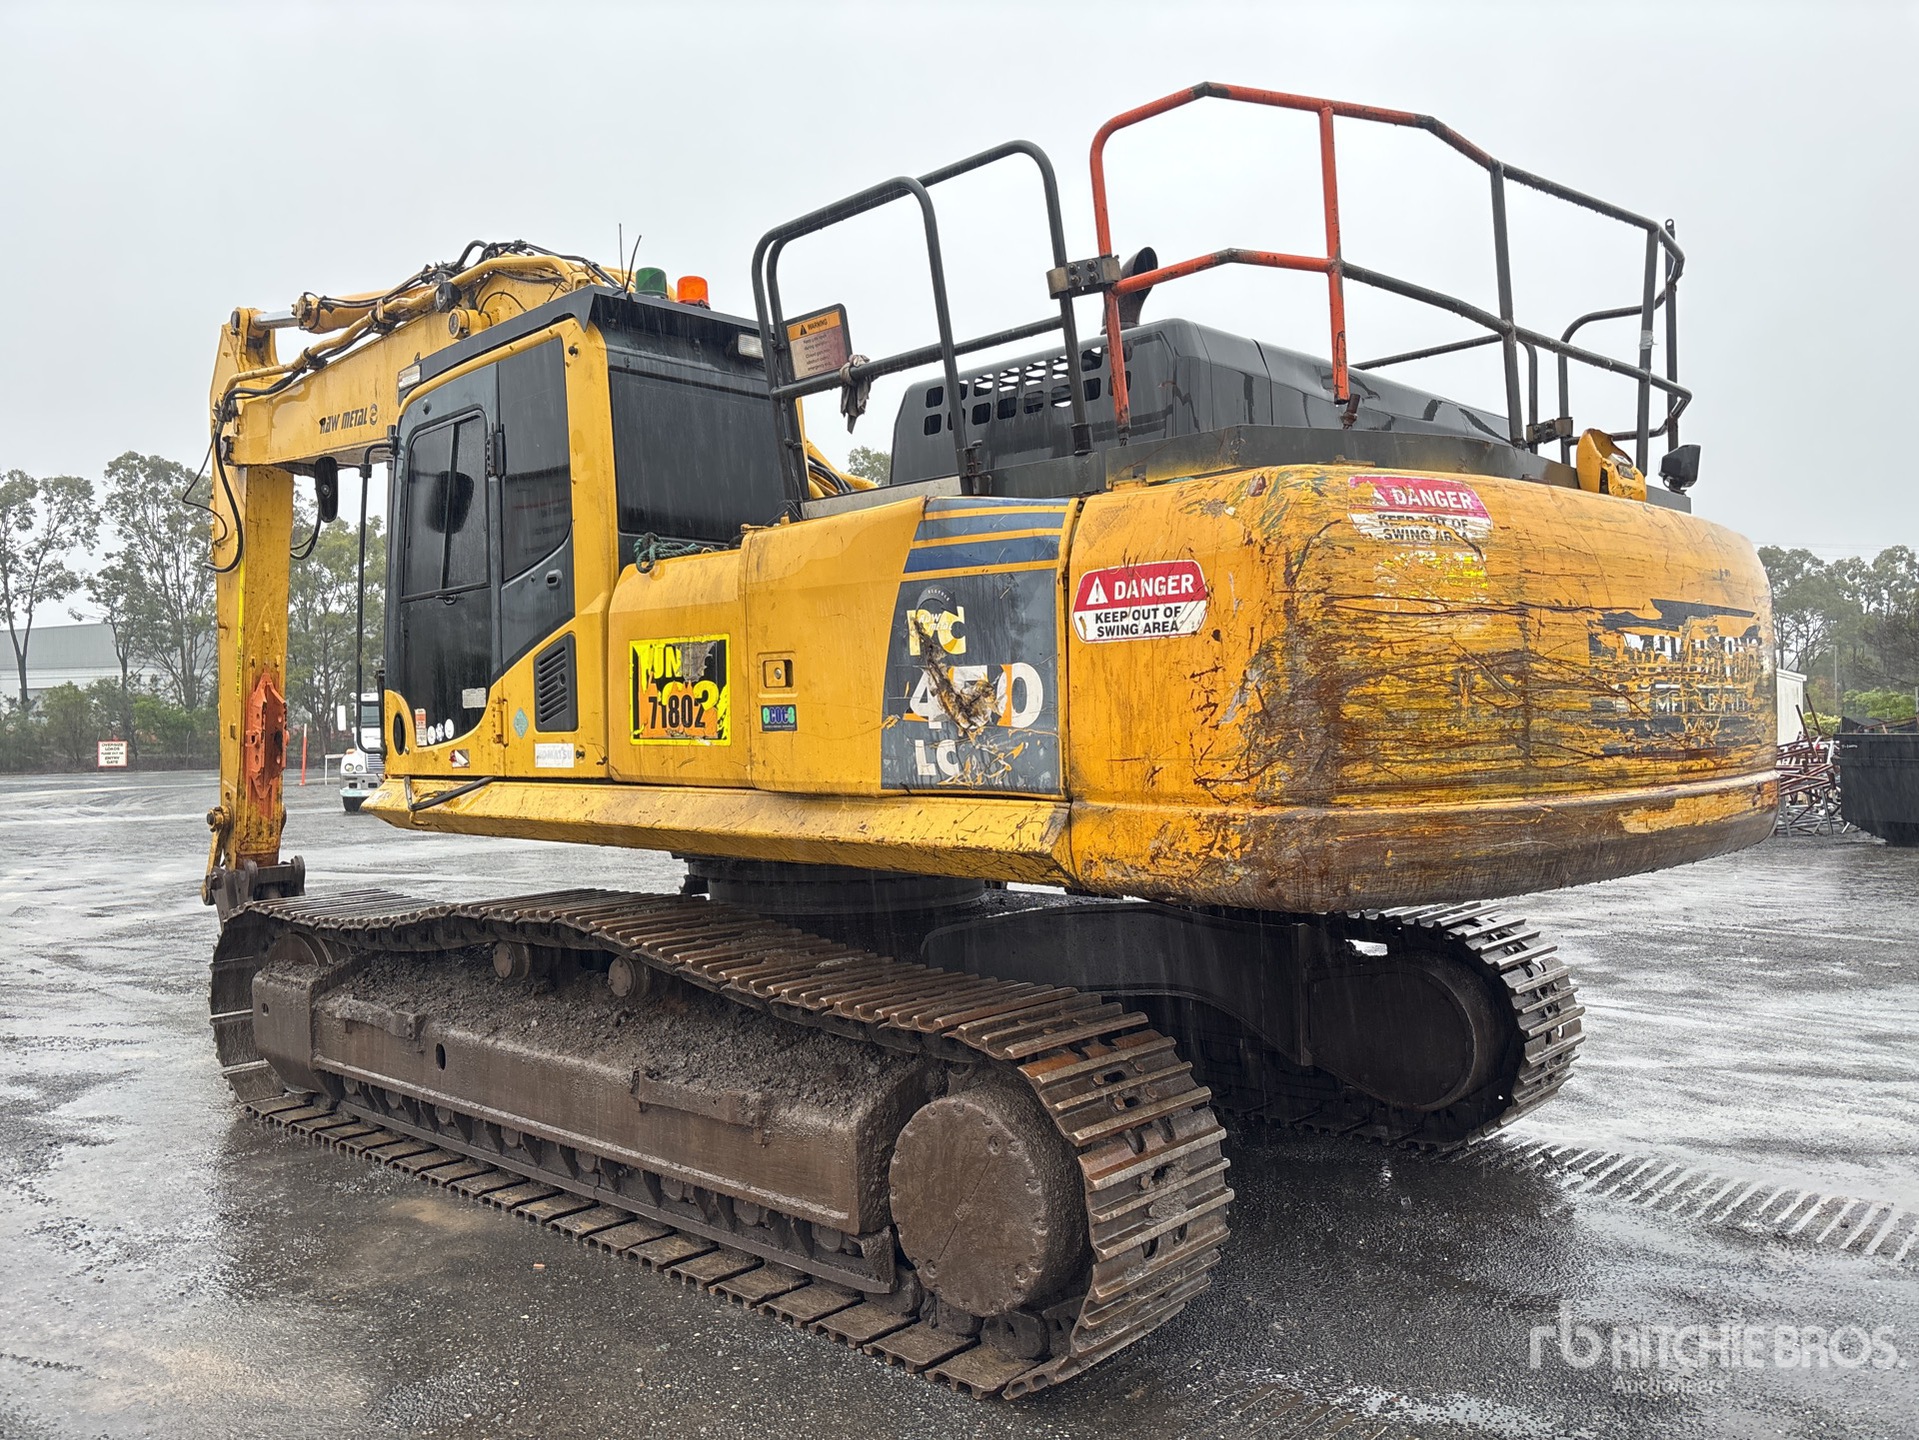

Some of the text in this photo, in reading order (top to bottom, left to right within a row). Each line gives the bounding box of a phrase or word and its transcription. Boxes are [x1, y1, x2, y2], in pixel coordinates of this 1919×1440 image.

[808, 319, 828, 330] WARNING
[1392, 487, 1475, 510] DANGER
[1383, 528, 1469, 542] SWING ARA
[1114, 573, 1194, 600] DANGER
[1095, 606, 1182, 624] KEEP OUT OF
[1097, 620, 1179, 638] SWING AREA
[648, 694, 706, 730] 71802
[914, 739, 960, 776] LC
